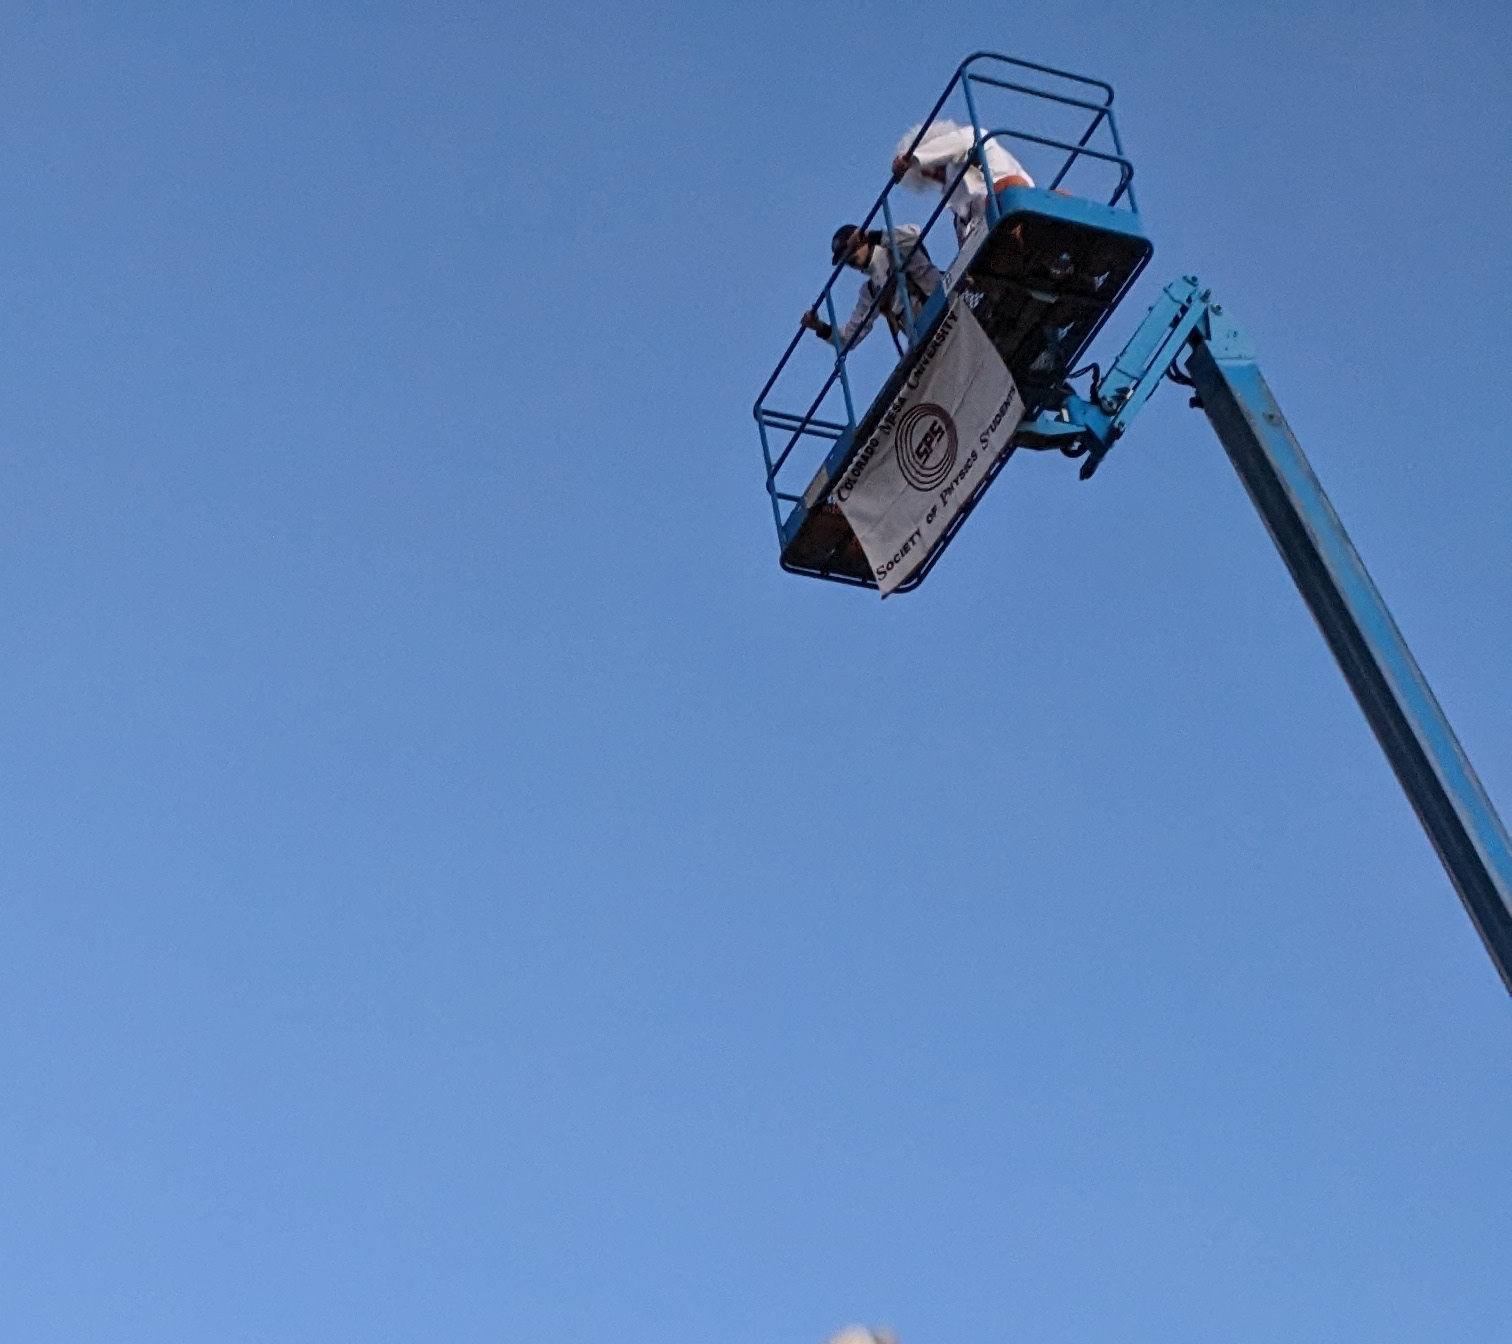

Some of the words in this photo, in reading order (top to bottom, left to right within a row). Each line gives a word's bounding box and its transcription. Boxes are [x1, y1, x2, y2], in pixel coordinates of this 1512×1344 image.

[914, 419, 945, 465] SPS
[876, 527, 921, 581] SOCIETY
[939, 449, 979, 507] PHYSICS
